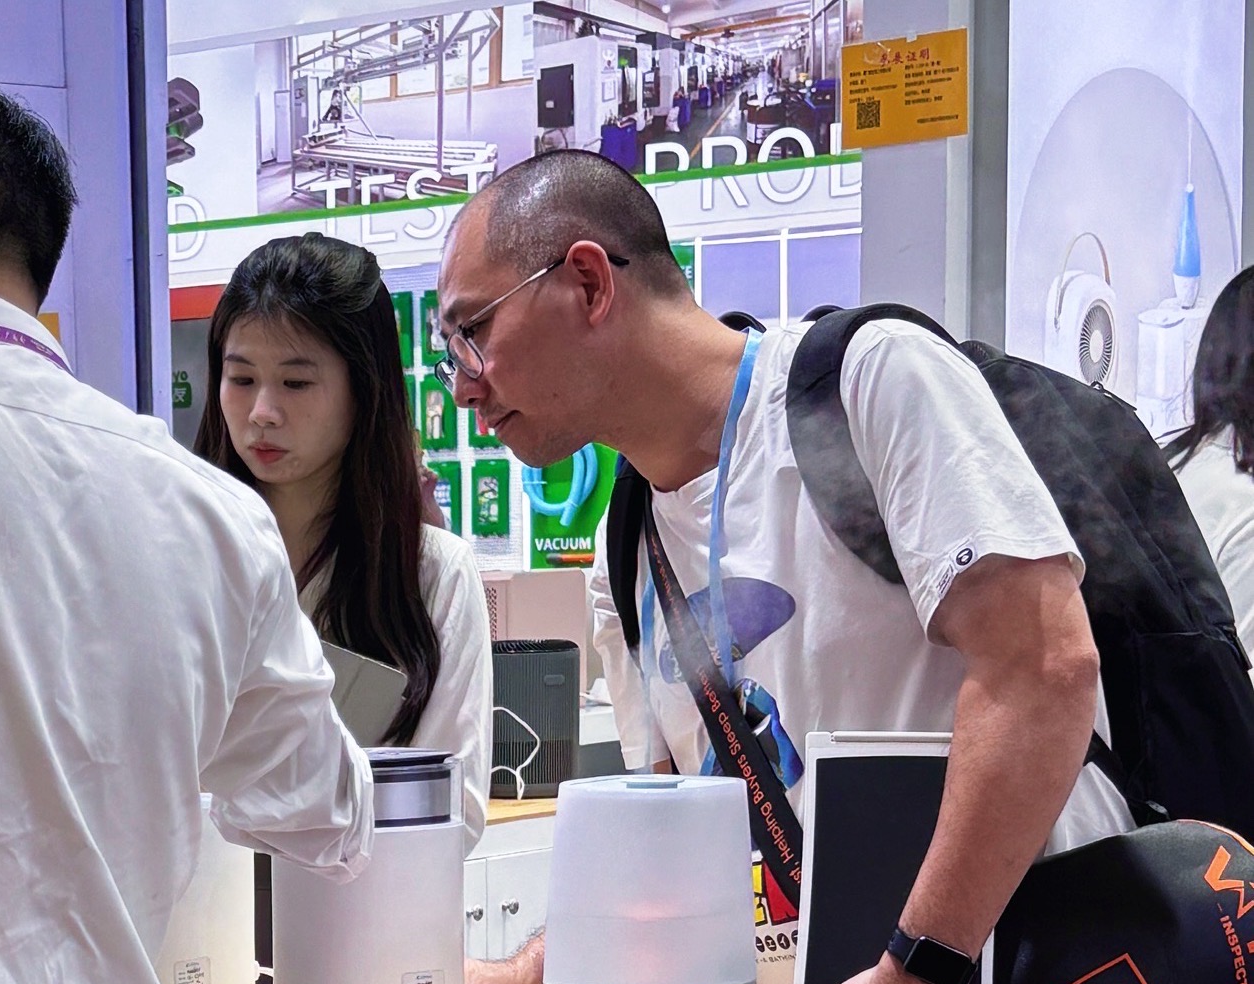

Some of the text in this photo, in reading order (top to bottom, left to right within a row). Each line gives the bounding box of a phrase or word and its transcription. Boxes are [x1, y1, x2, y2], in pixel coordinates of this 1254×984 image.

[534, 535, 593, 552] VACUUM
[718, 710, 742, 757] Sleep
[737, 754, 764, 806] Buyers
[760, 800, 795, 865] Helping
